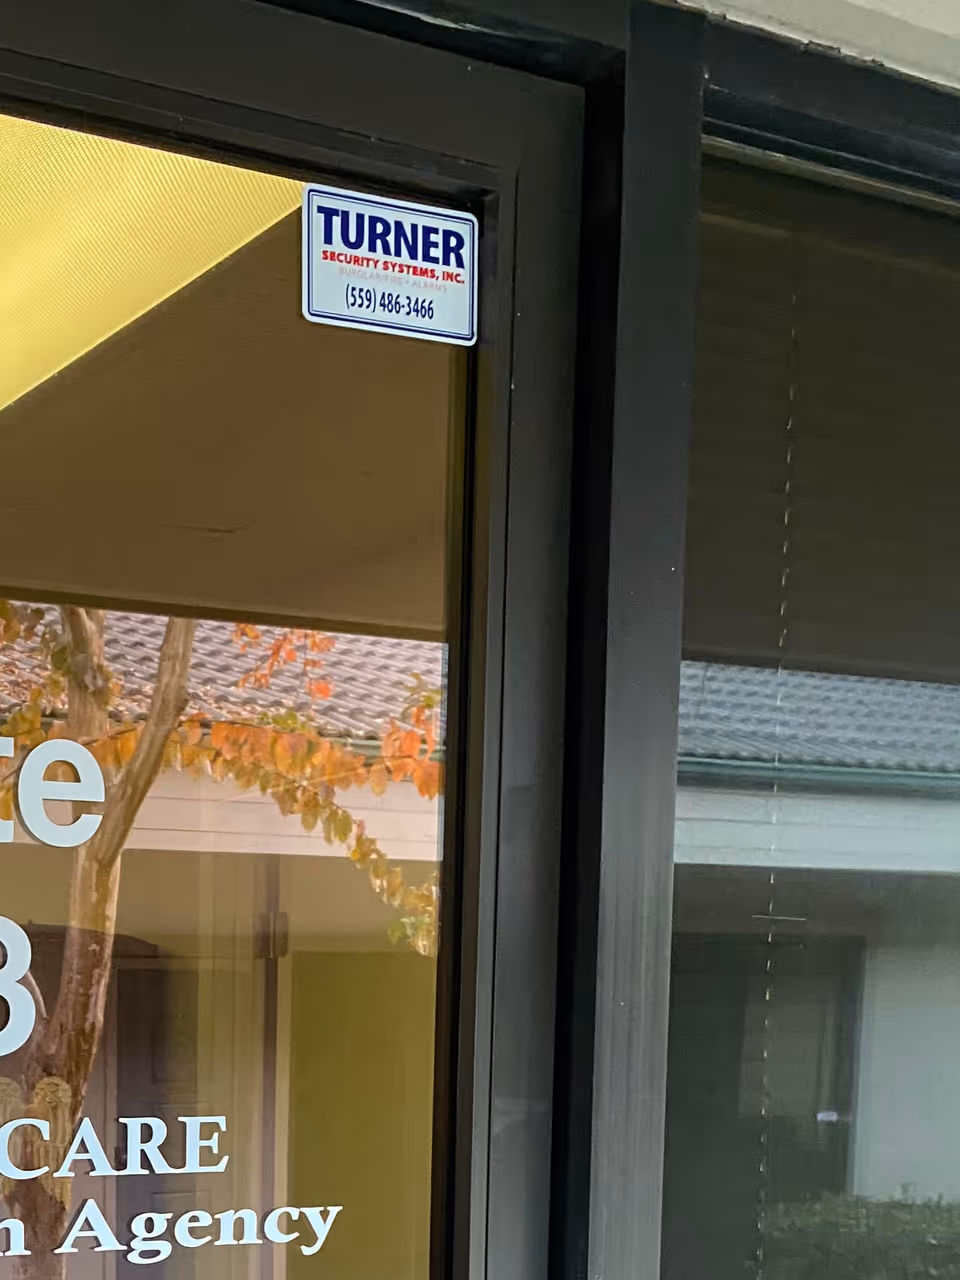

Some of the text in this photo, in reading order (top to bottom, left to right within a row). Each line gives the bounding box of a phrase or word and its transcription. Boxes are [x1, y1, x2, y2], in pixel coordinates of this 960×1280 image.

[317, 205, 465, 269] TURNER
[322, 250, 465, 284] SECURITY SYSTEMS, INC.
[346, 283, 435, 320] (559) 486-3466
[54, 1198, 343, 1265] Agency
